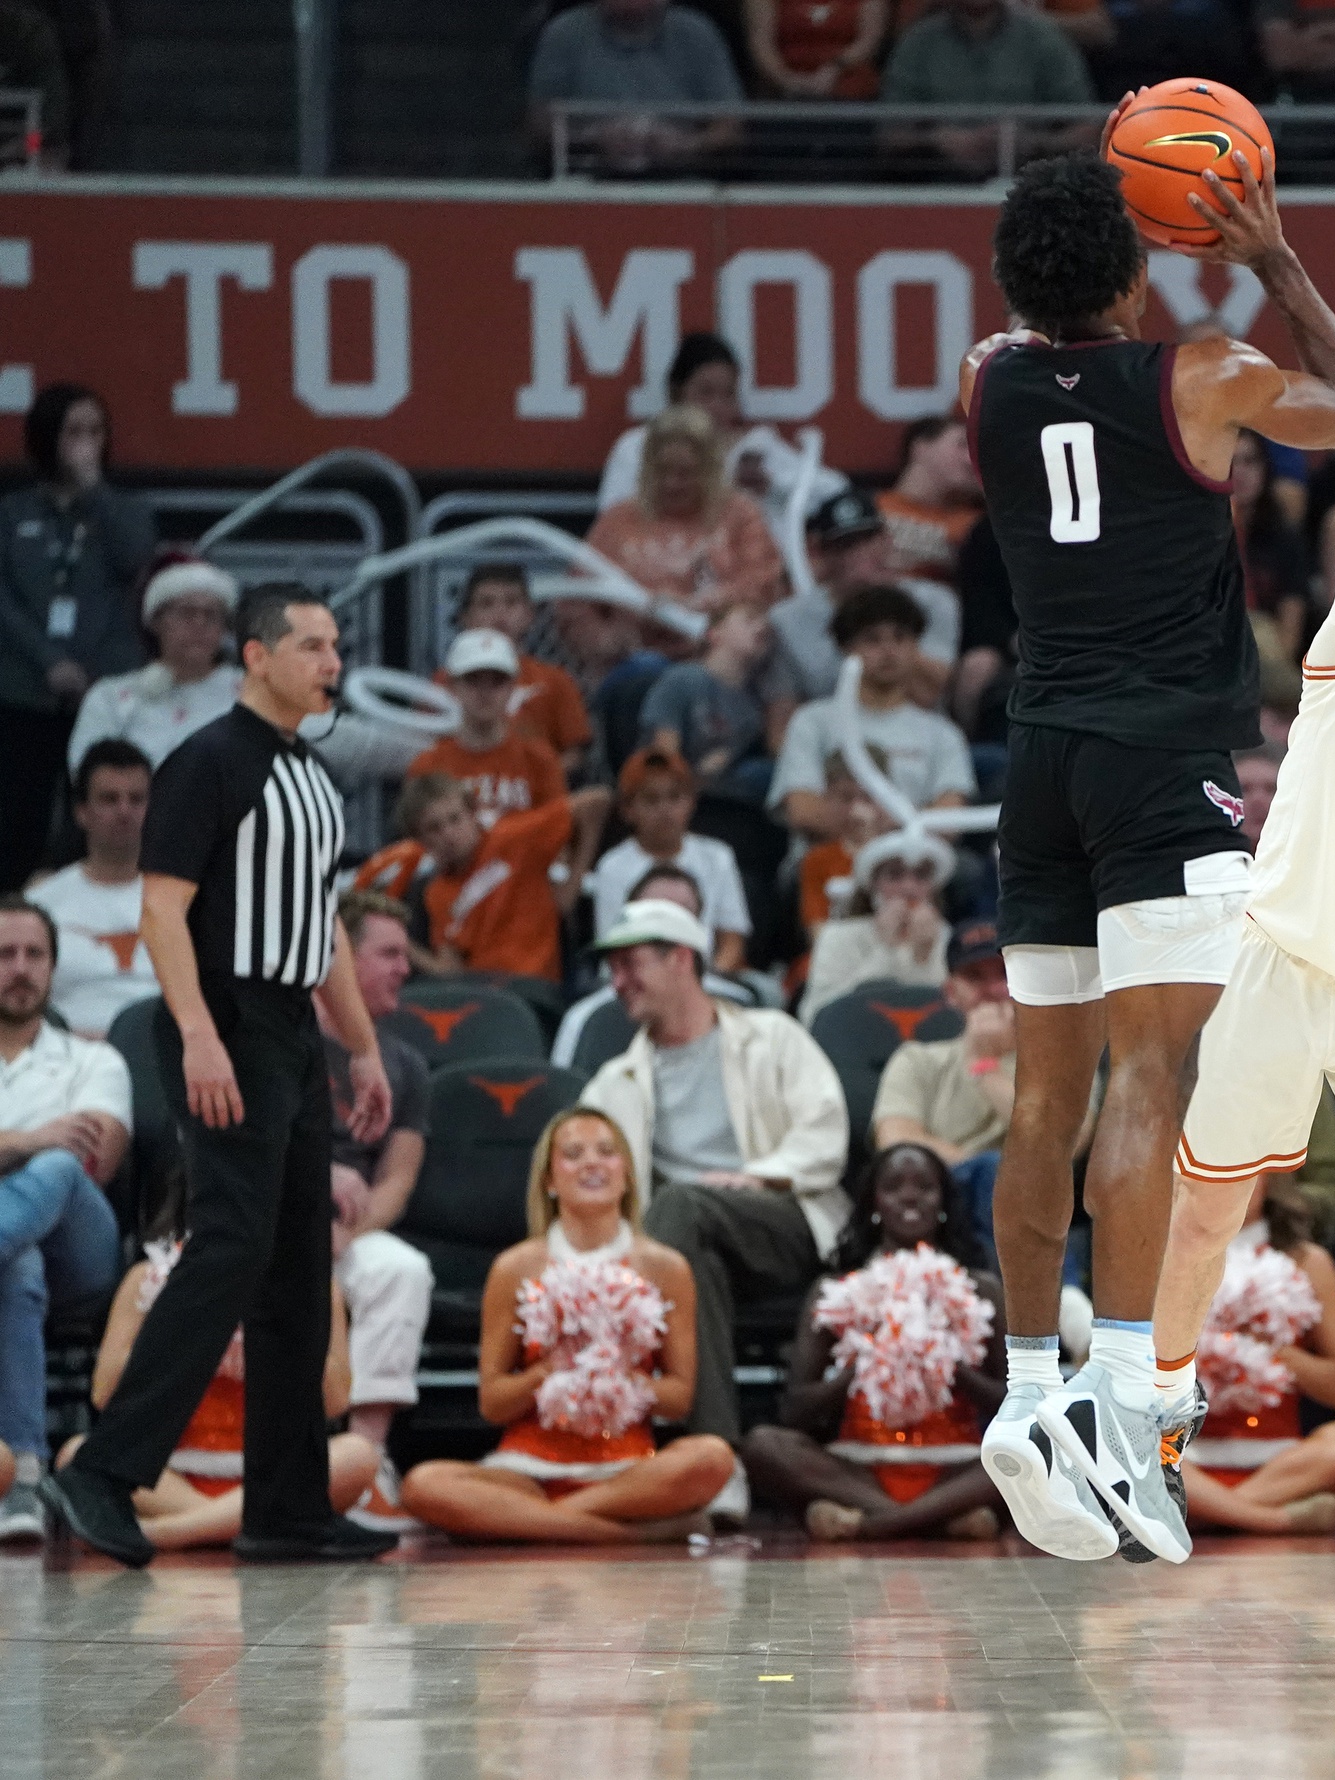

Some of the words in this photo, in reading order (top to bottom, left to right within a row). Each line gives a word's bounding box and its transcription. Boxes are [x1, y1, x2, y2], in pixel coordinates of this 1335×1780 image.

[133, 240, 410, 417] TO
[514, 246, 1268, 421] MOOY
[1041, 421, 1100, 543] 0
